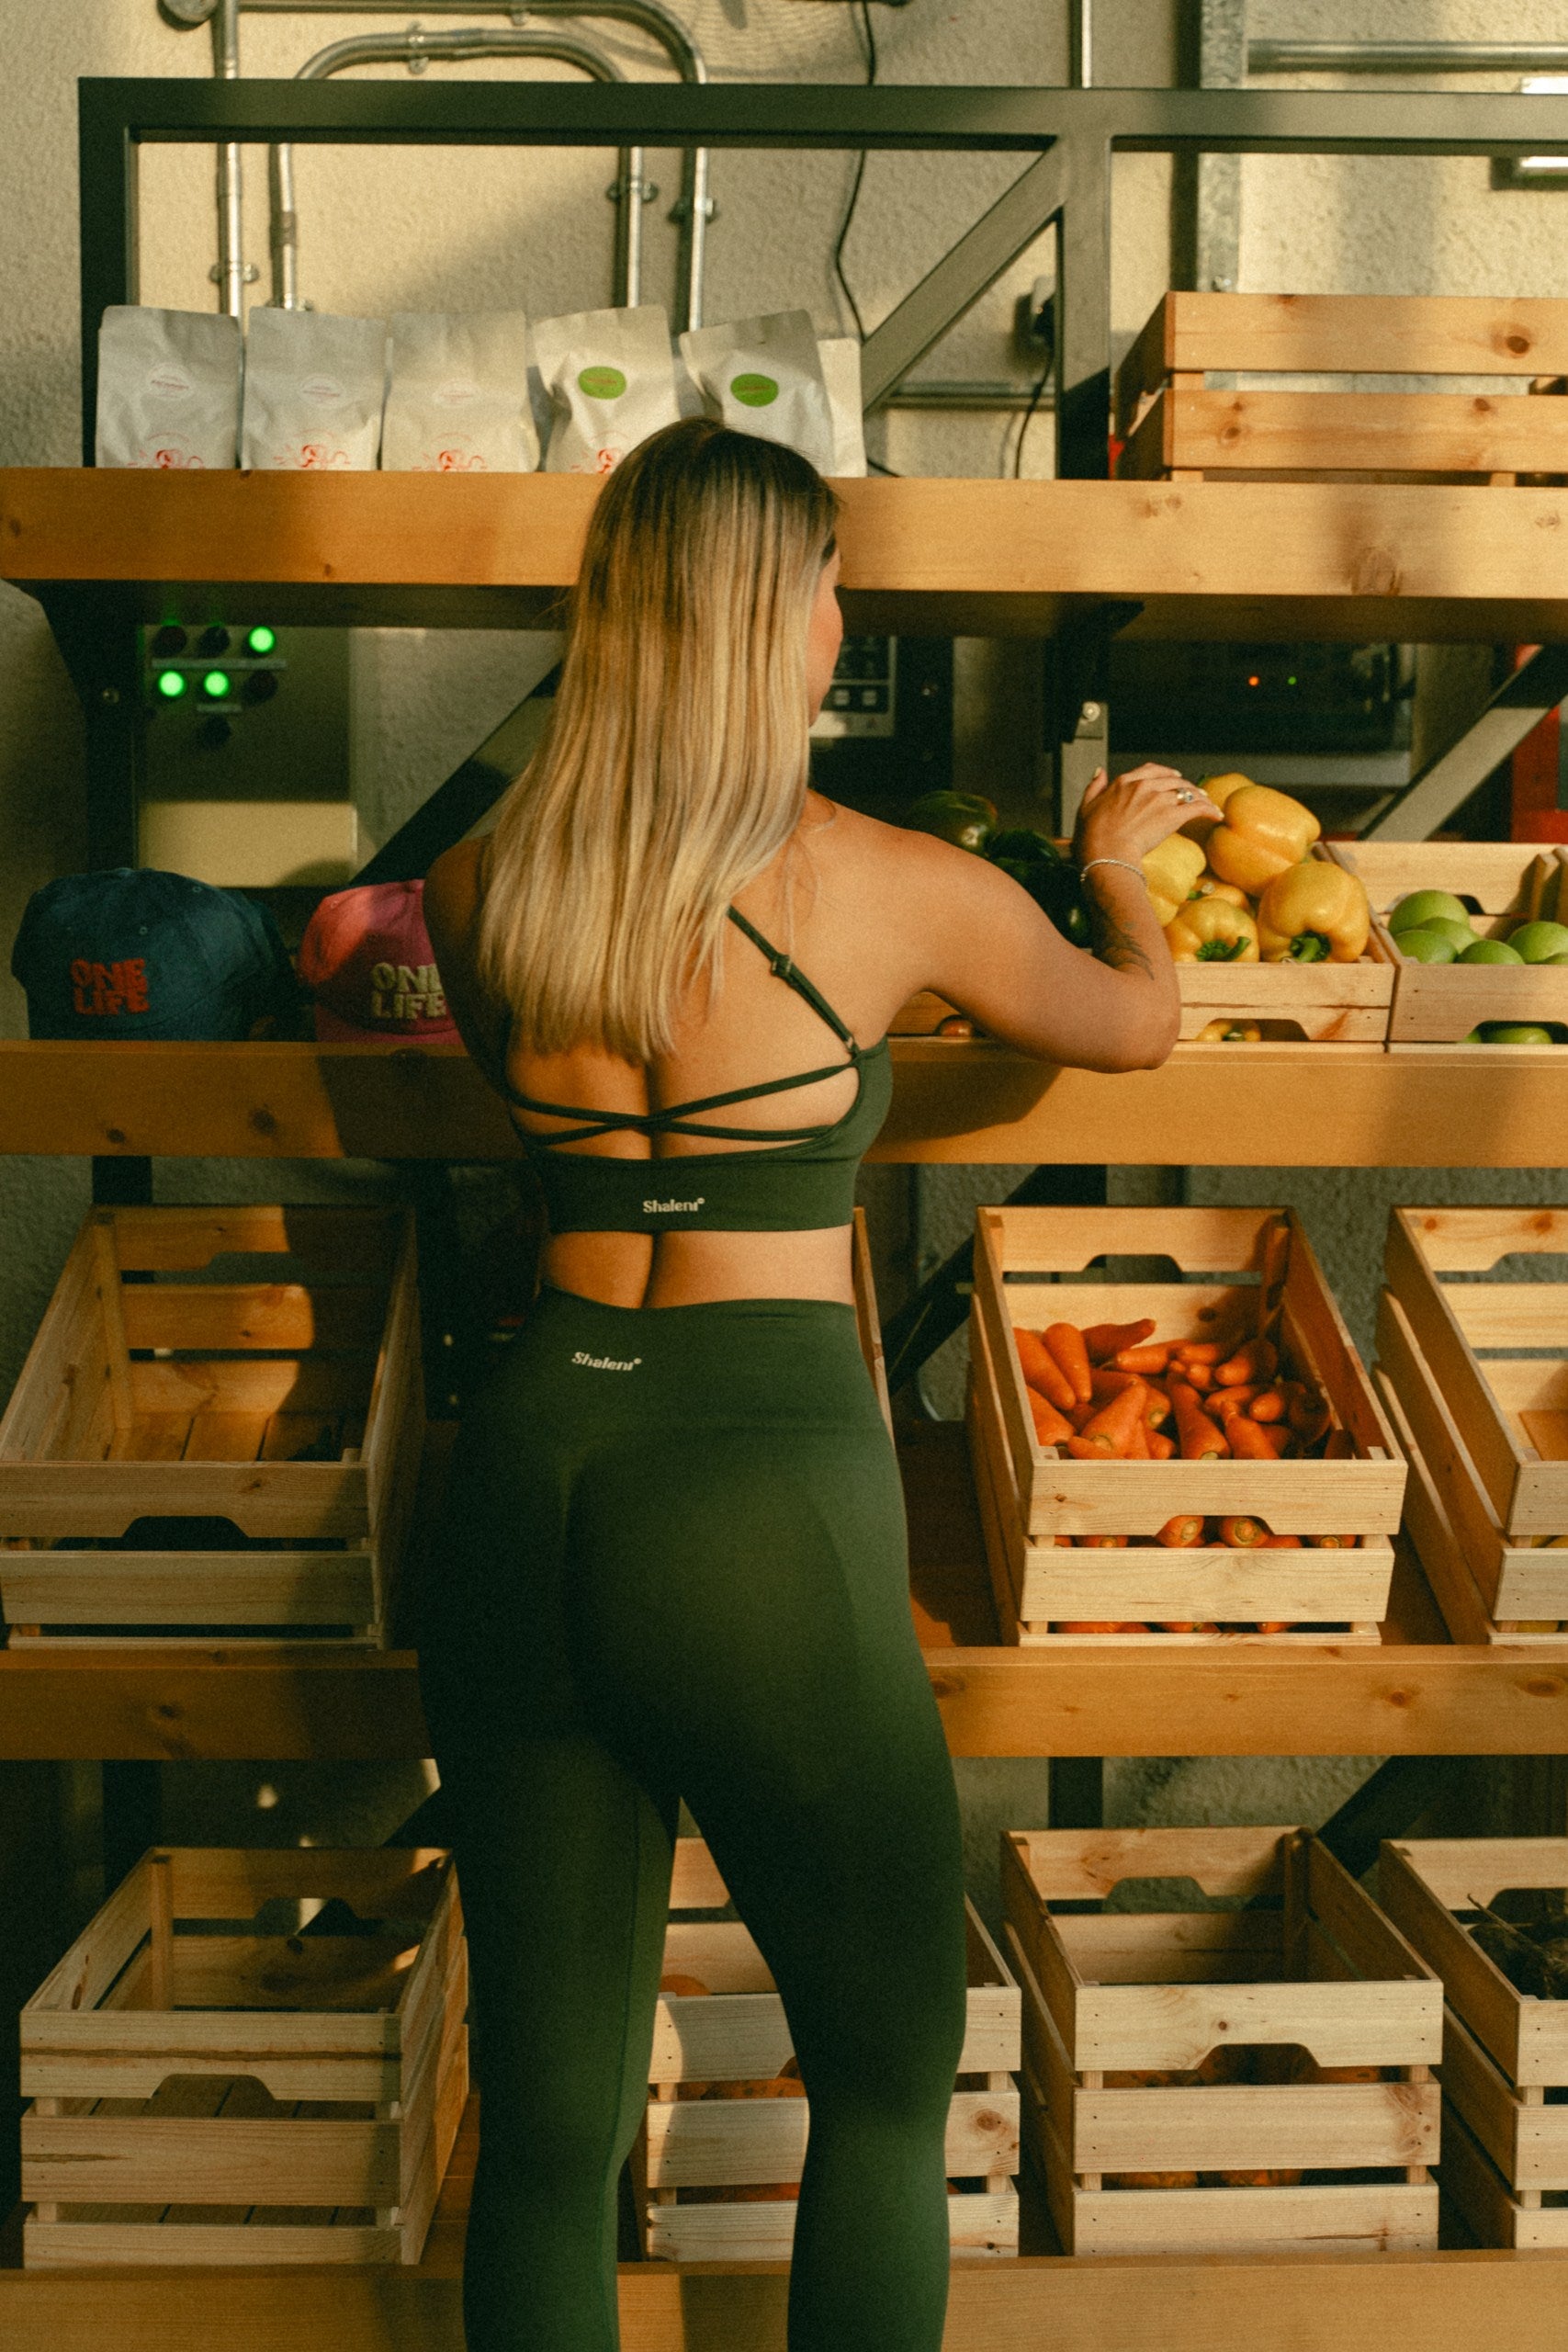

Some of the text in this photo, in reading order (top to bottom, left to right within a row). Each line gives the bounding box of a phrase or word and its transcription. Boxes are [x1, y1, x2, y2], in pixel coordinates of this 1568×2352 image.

[71, 957, 148, 993] ONE
[73, 987, 150, 1016] LIFE
[371, 990, 447, 1019] LIFE
